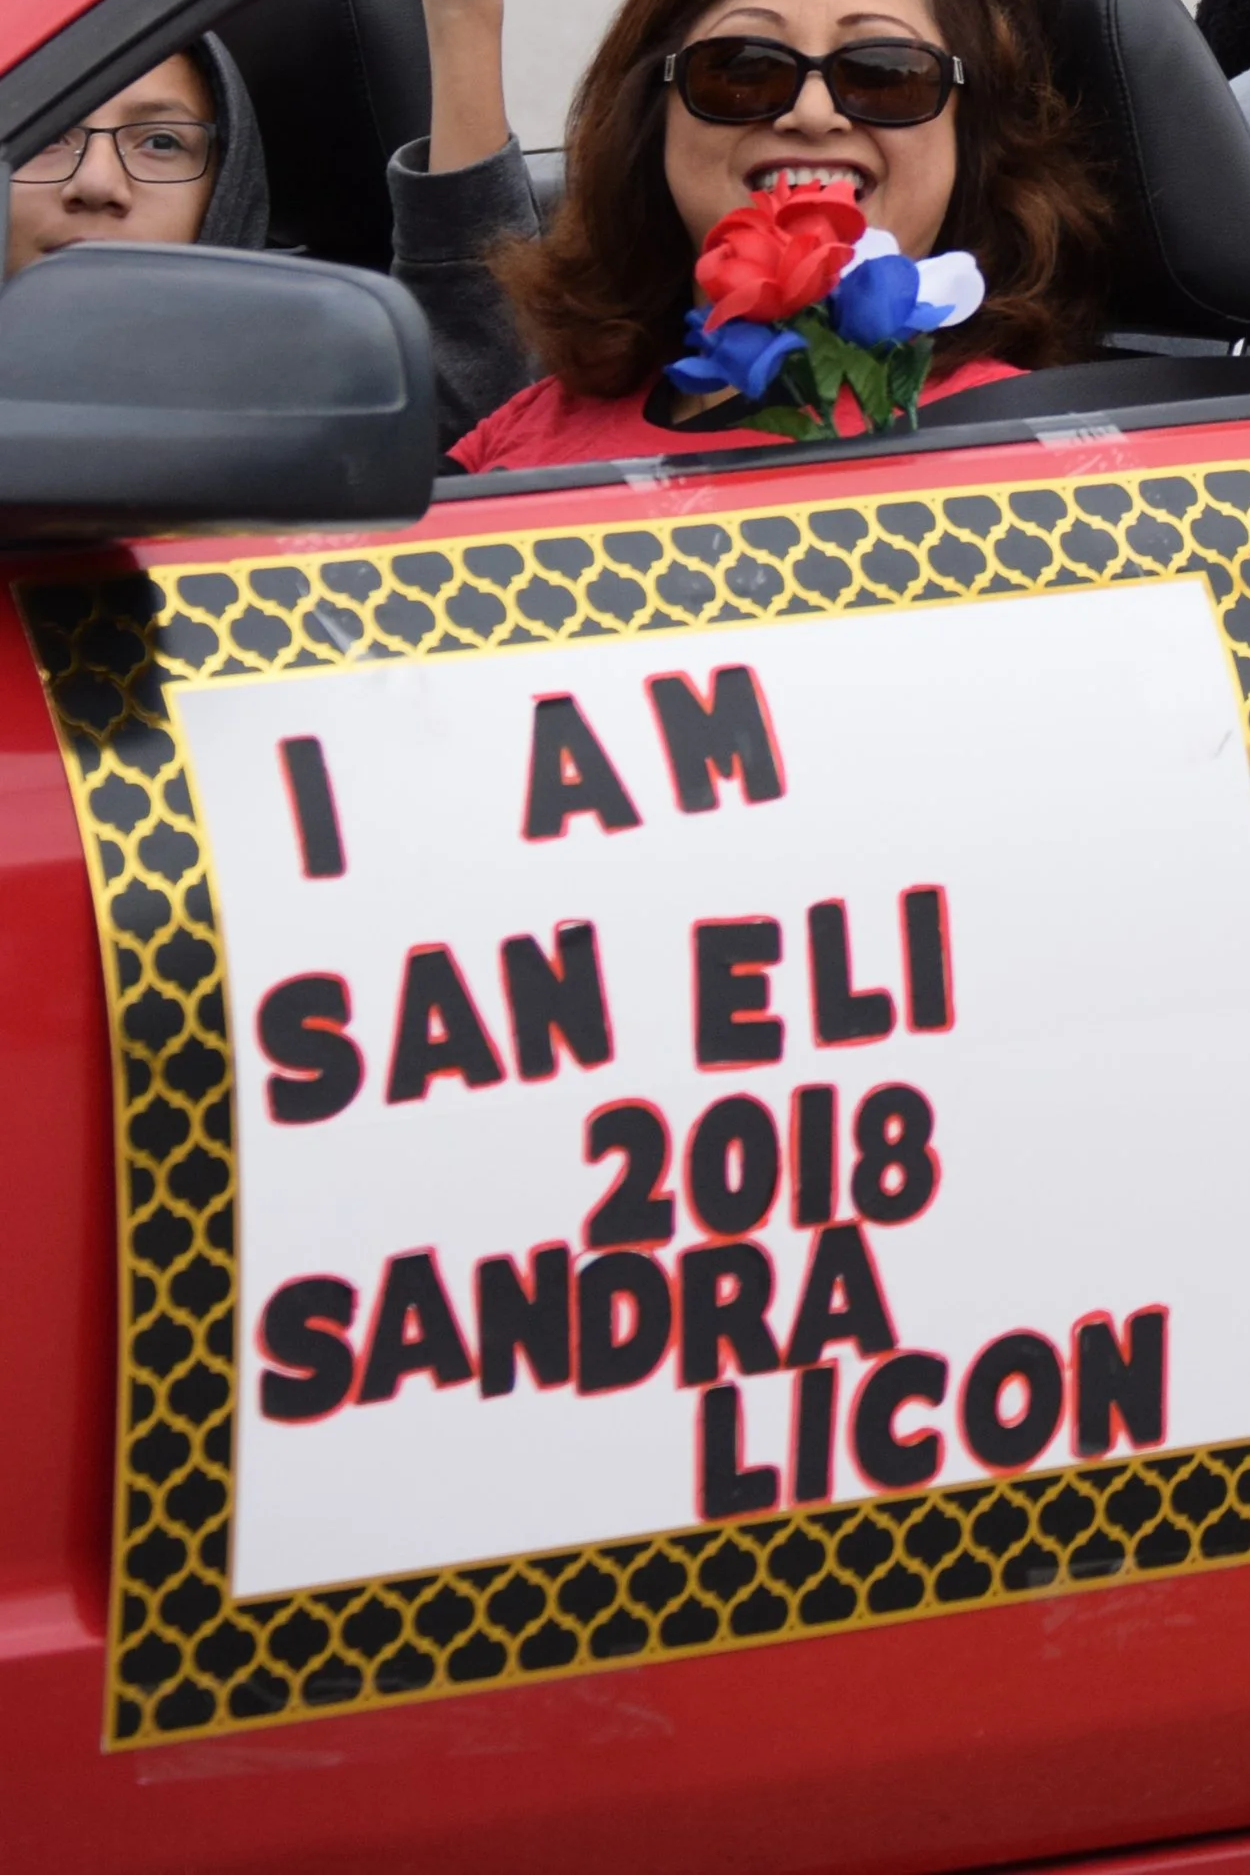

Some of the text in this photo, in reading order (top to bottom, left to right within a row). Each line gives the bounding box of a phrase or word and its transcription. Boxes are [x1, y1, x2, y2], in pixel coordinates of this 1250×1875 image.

[277, 663, 787, 879] I AM
[255, 884, 954, 1124] SAN ELI
[583, 1081, 942, 1251] 2018
[256, 1220, 899, 1423] SANDRA
[694, 1303, 1170, 1522] LICON
